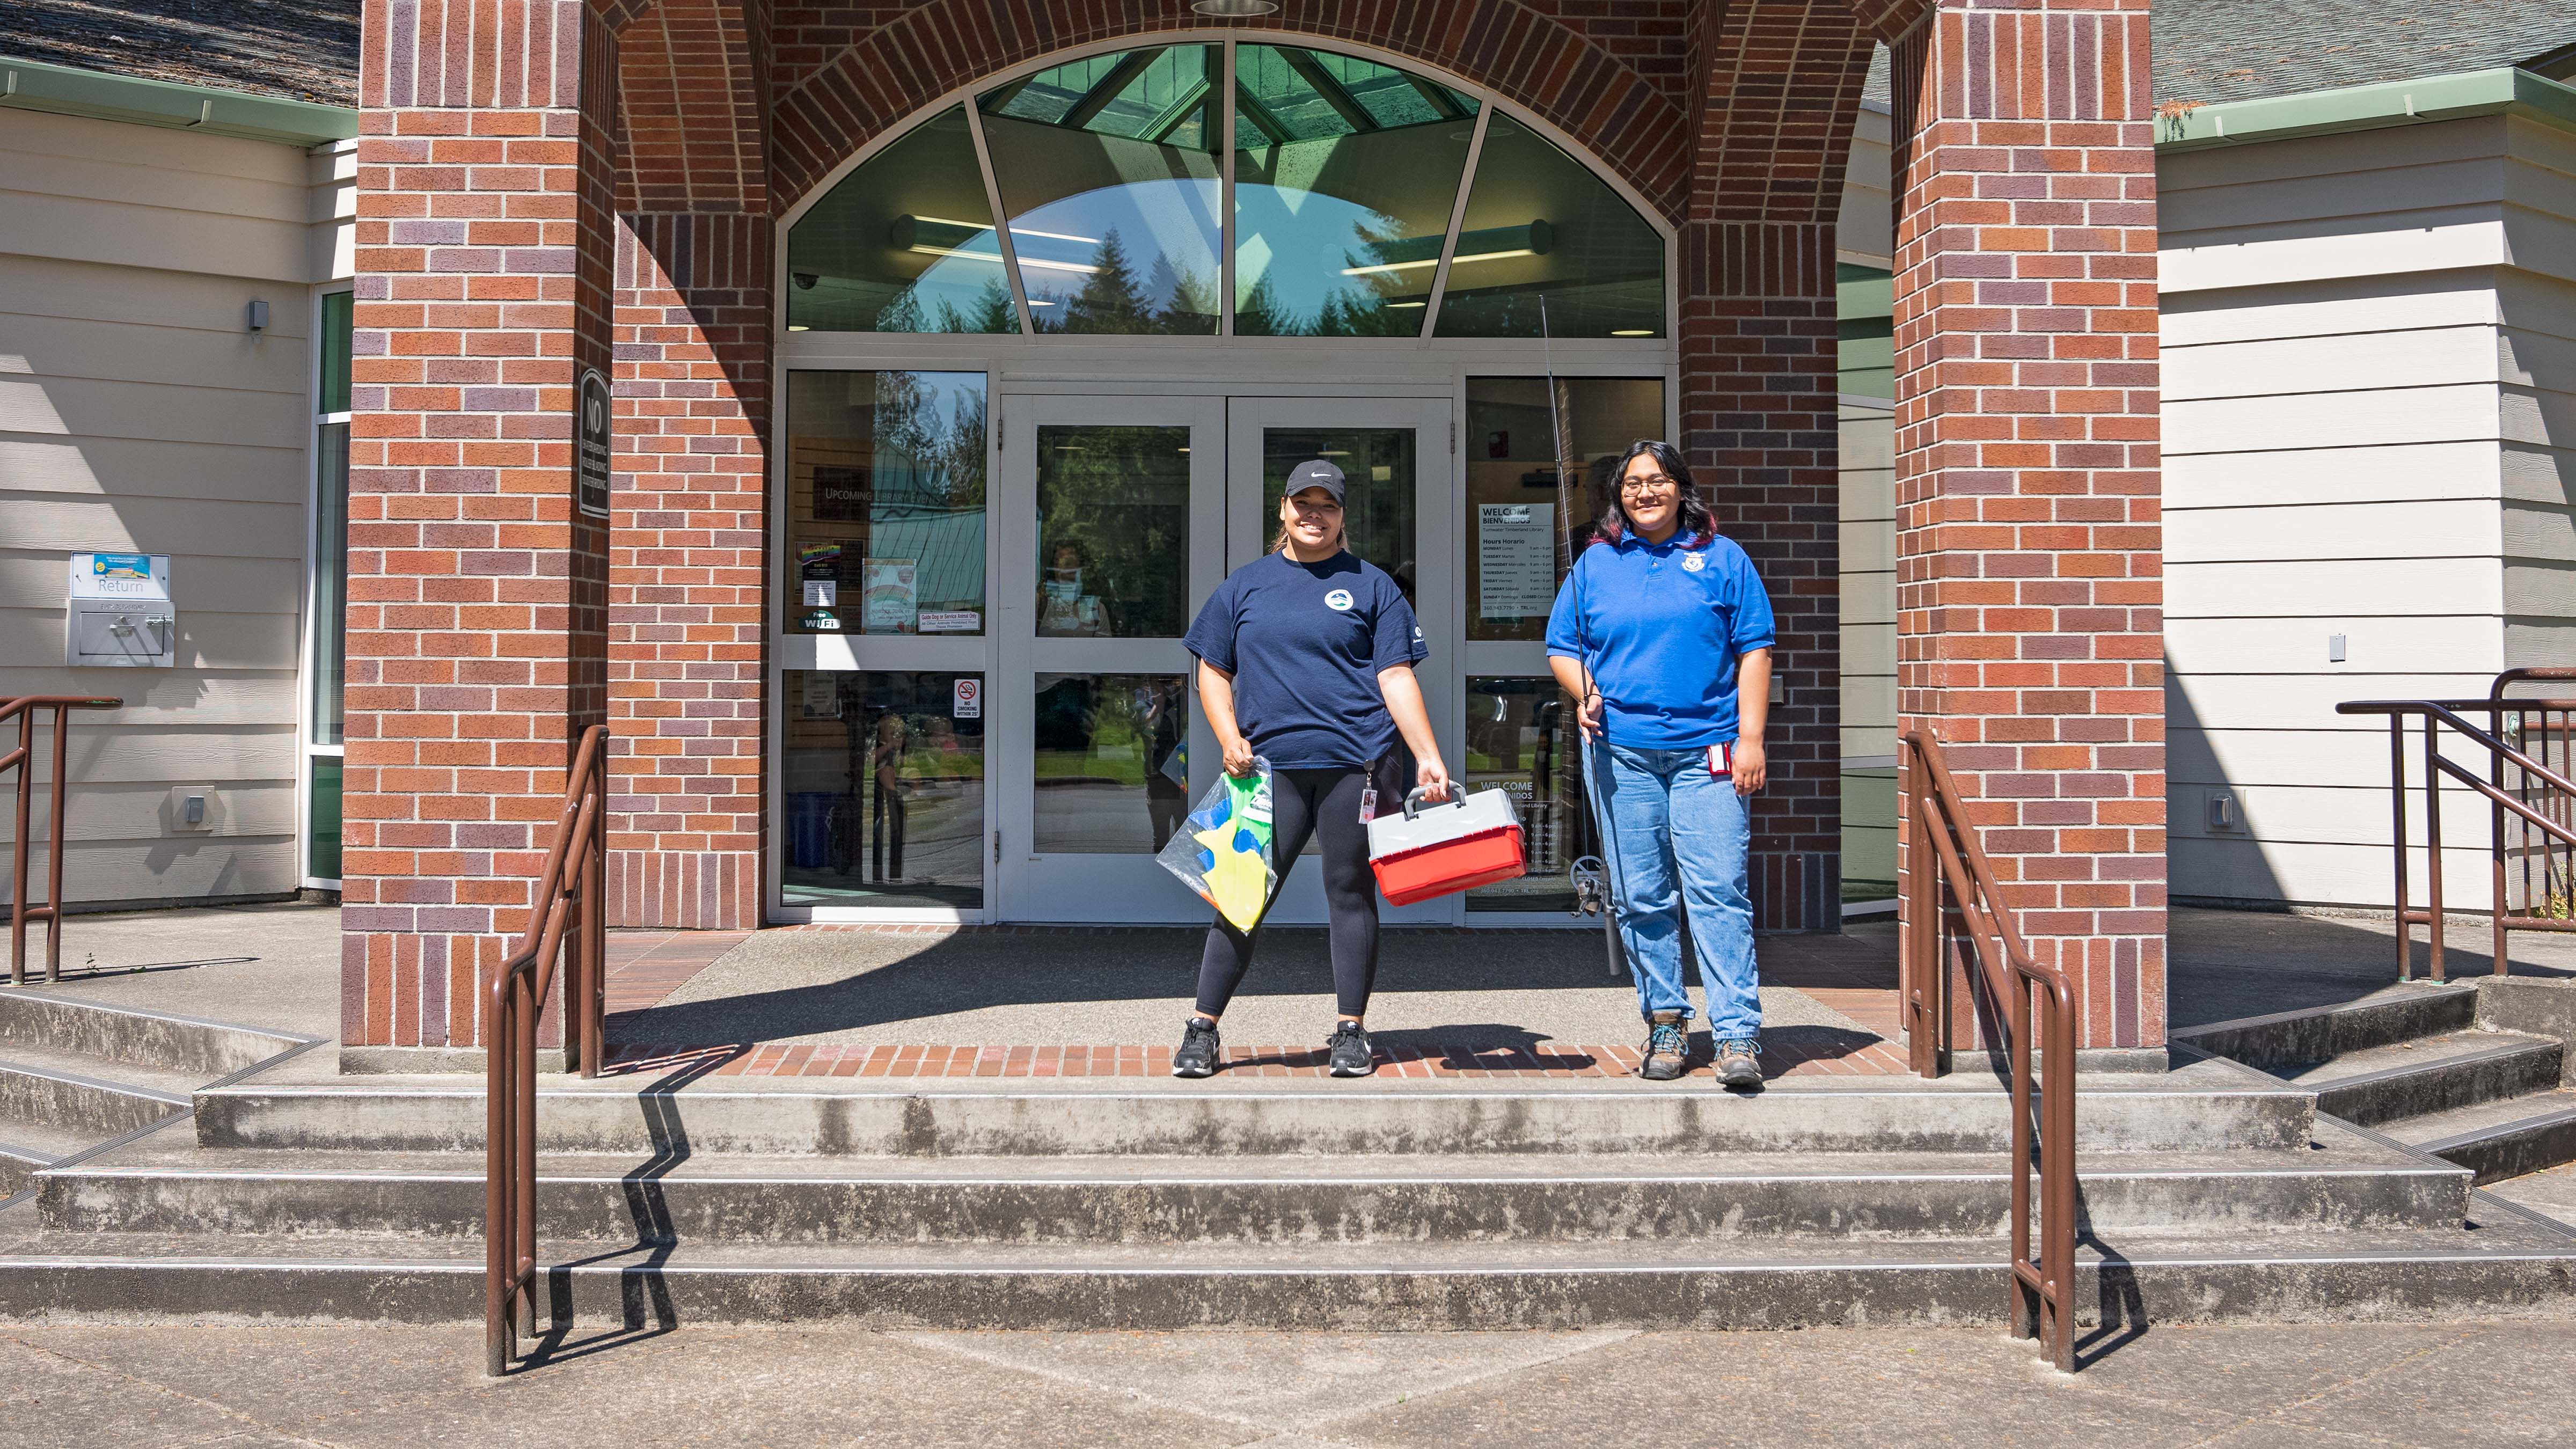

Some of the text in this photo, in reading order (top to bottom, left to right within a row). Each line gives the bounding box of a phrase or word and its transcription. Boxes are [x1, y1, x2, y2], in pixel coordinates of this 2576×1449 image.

[587, 397, 602, 434] NO
[825, 488, 940, 504] UPCOMING LIBRARY EVENTS
[1483, 508, 1531, 516] WELCOME
[98, 579, 143, 592] Return
[1481, 781, 1533, 791] WELCOME
